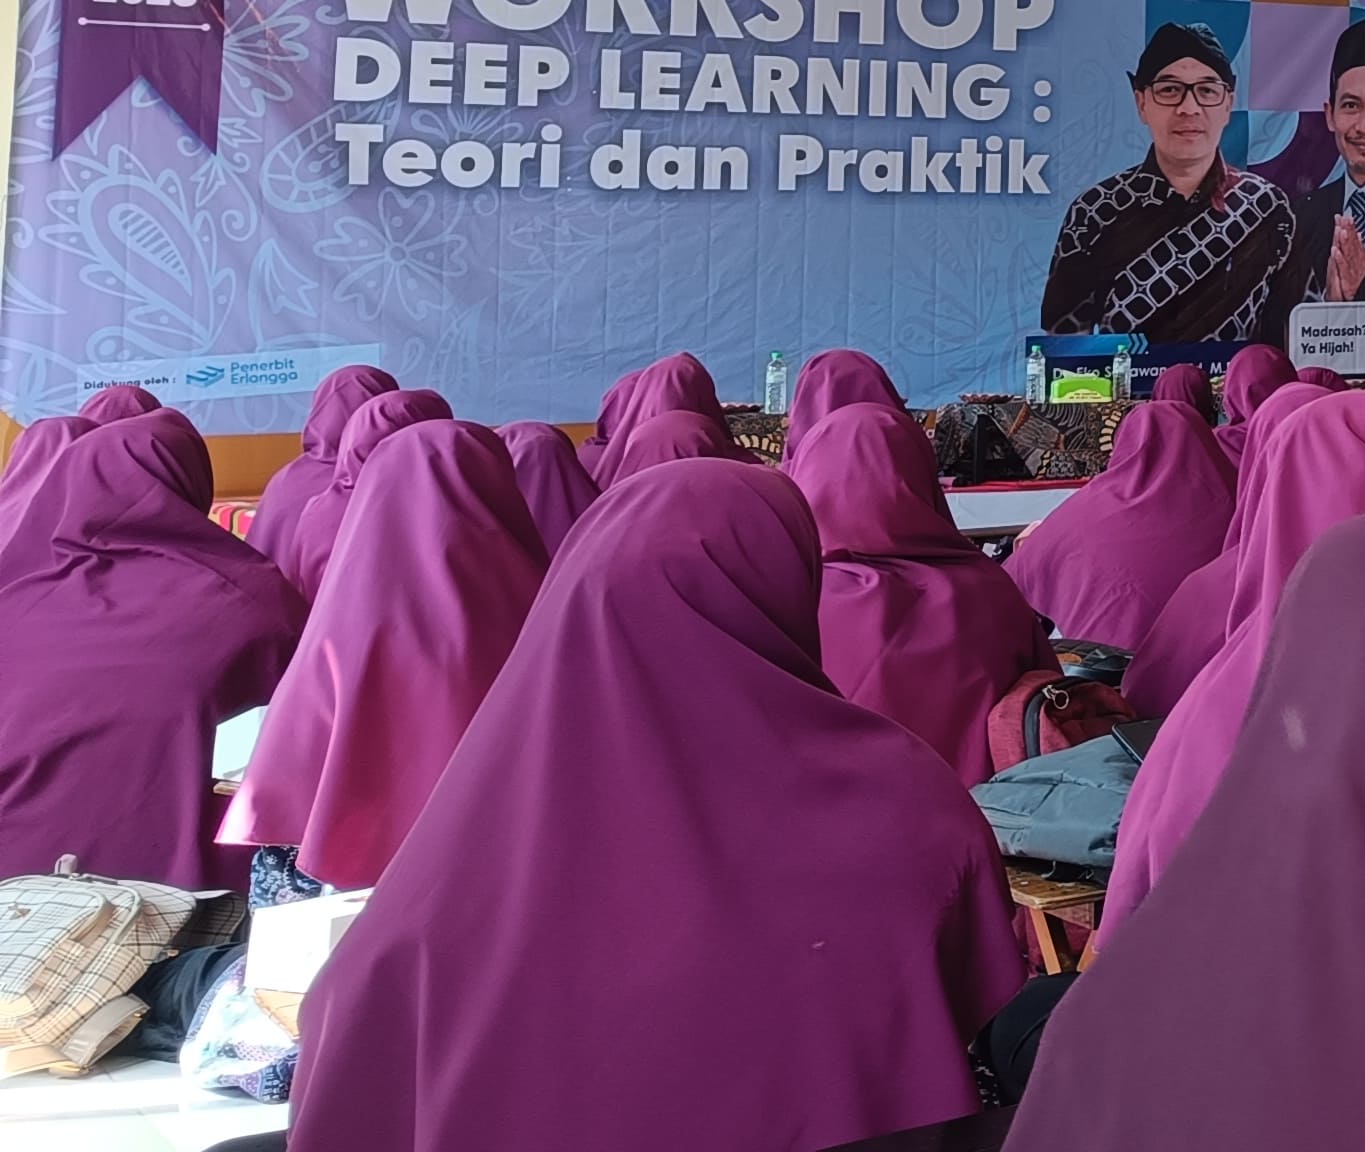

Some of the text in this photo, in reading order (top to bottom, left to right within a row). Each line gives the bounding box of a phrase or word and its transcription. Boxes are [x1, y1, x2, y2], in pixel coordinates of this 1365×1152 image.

[334, 37, 570, 106] DEEP
[600, 48, 1011, 121] LEARNING
[335, 123, 1051, 194] Teori dan Praktik
[1301, 341, 1354, 356] Ya Hijah!
[230, 358, 295, 373] Penerbit
[144, 376, 169, 386] oleh
[230, 370, 298, 386] Erlangga
